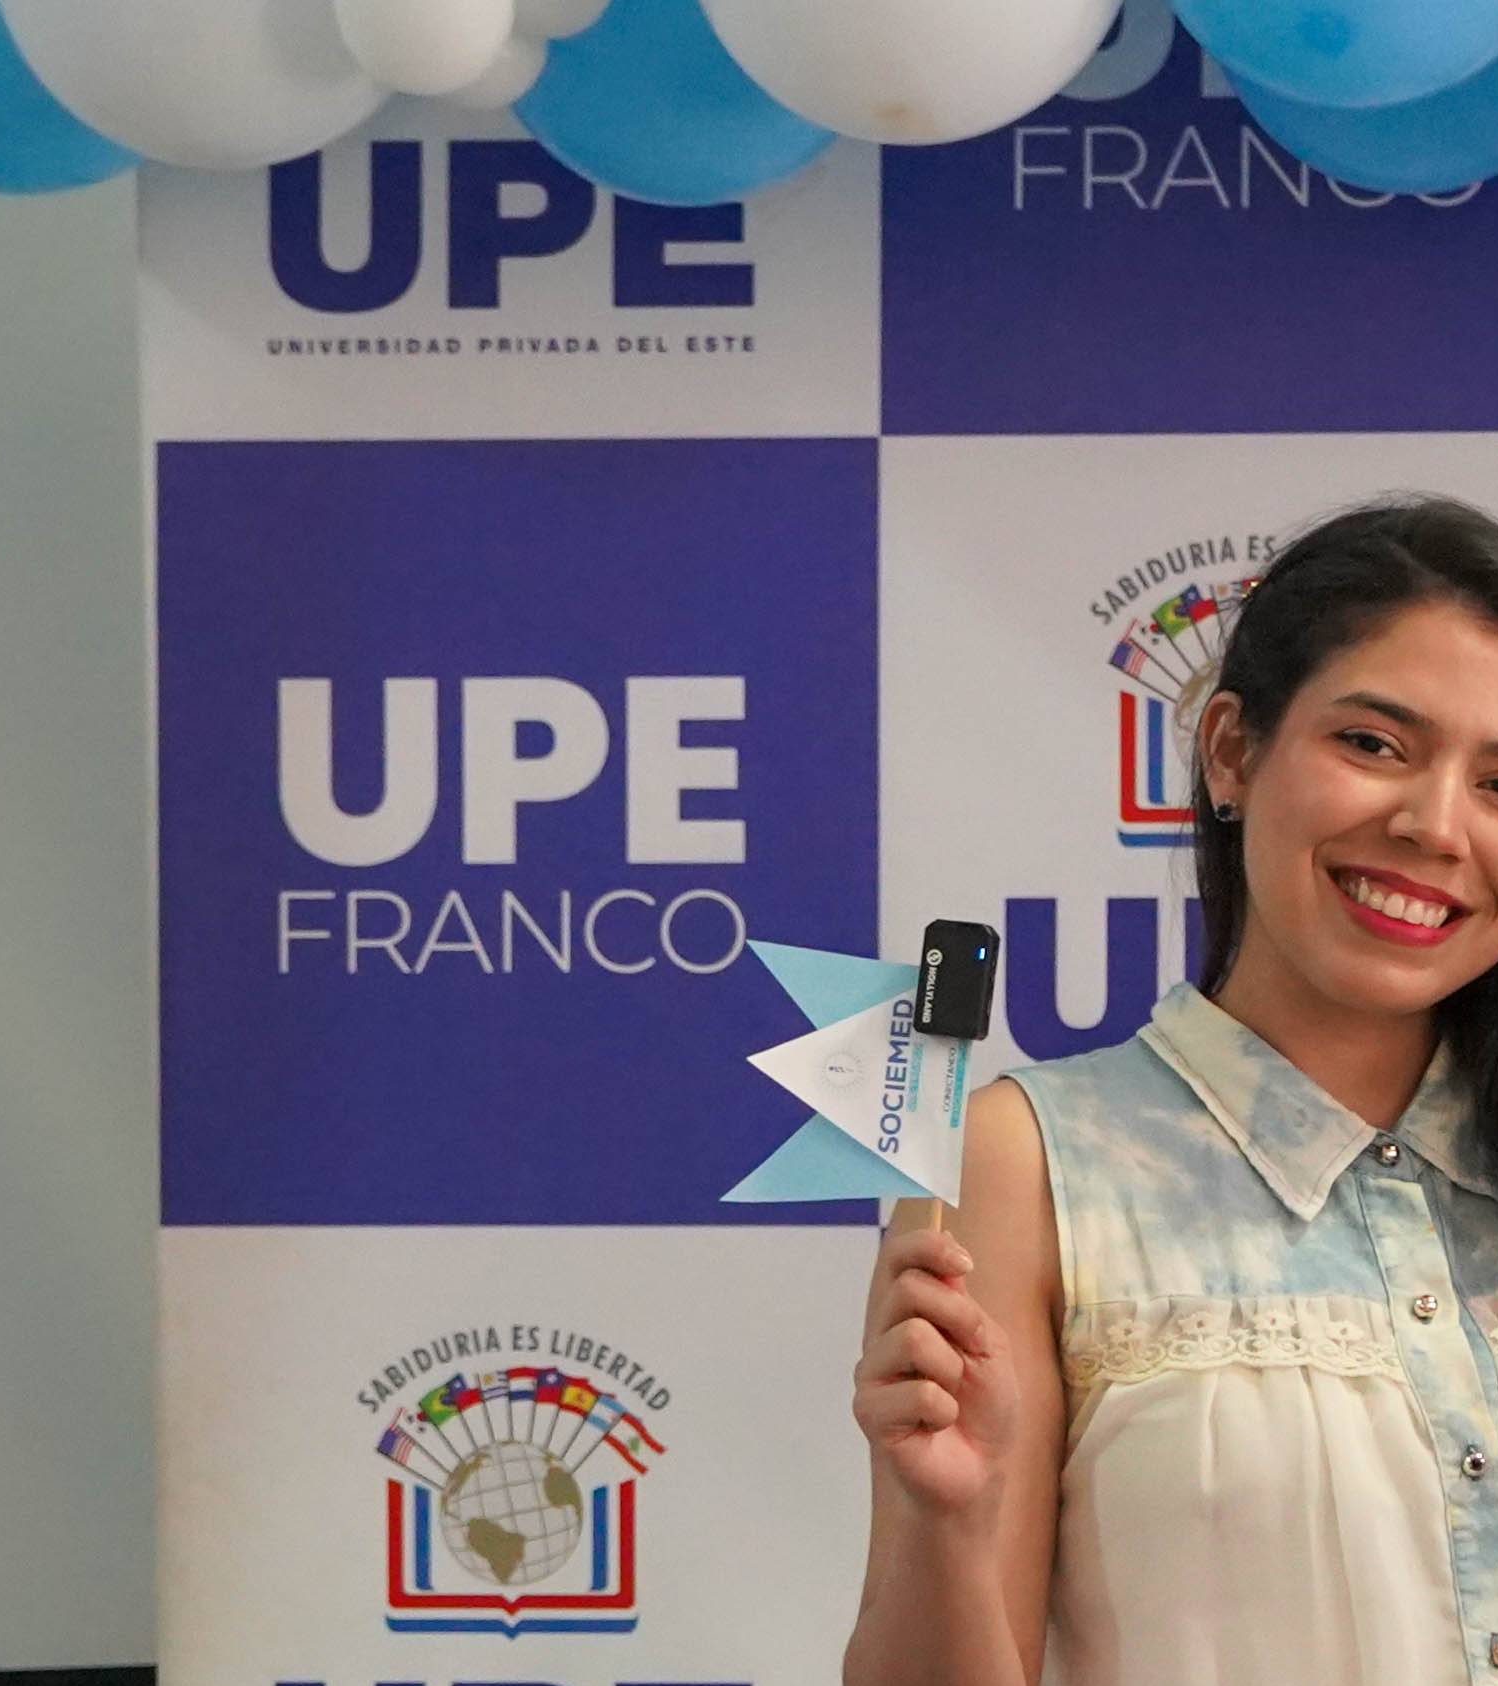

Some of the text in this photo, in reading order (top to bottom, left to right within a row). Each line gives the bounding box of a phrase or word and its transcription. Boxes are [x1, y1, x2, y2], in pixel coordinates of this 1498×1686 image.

[1013, 124, 1482, 209] FRAN
[268, 139, 754, 312] UPE
[268, 337, 756, 355] UNIVERSIDAD PRIVADA DEL ESTE
[1090, 537, 1236, 625] SABIDURIA
[278, 676, 747, 866] UPE
[278, 889, 747, 974] FRANCO
[877, 999, 915, 1154] SOCIEMED
[358, 1324, 672, 1415] SABIDURIA ES LIBERTAD
